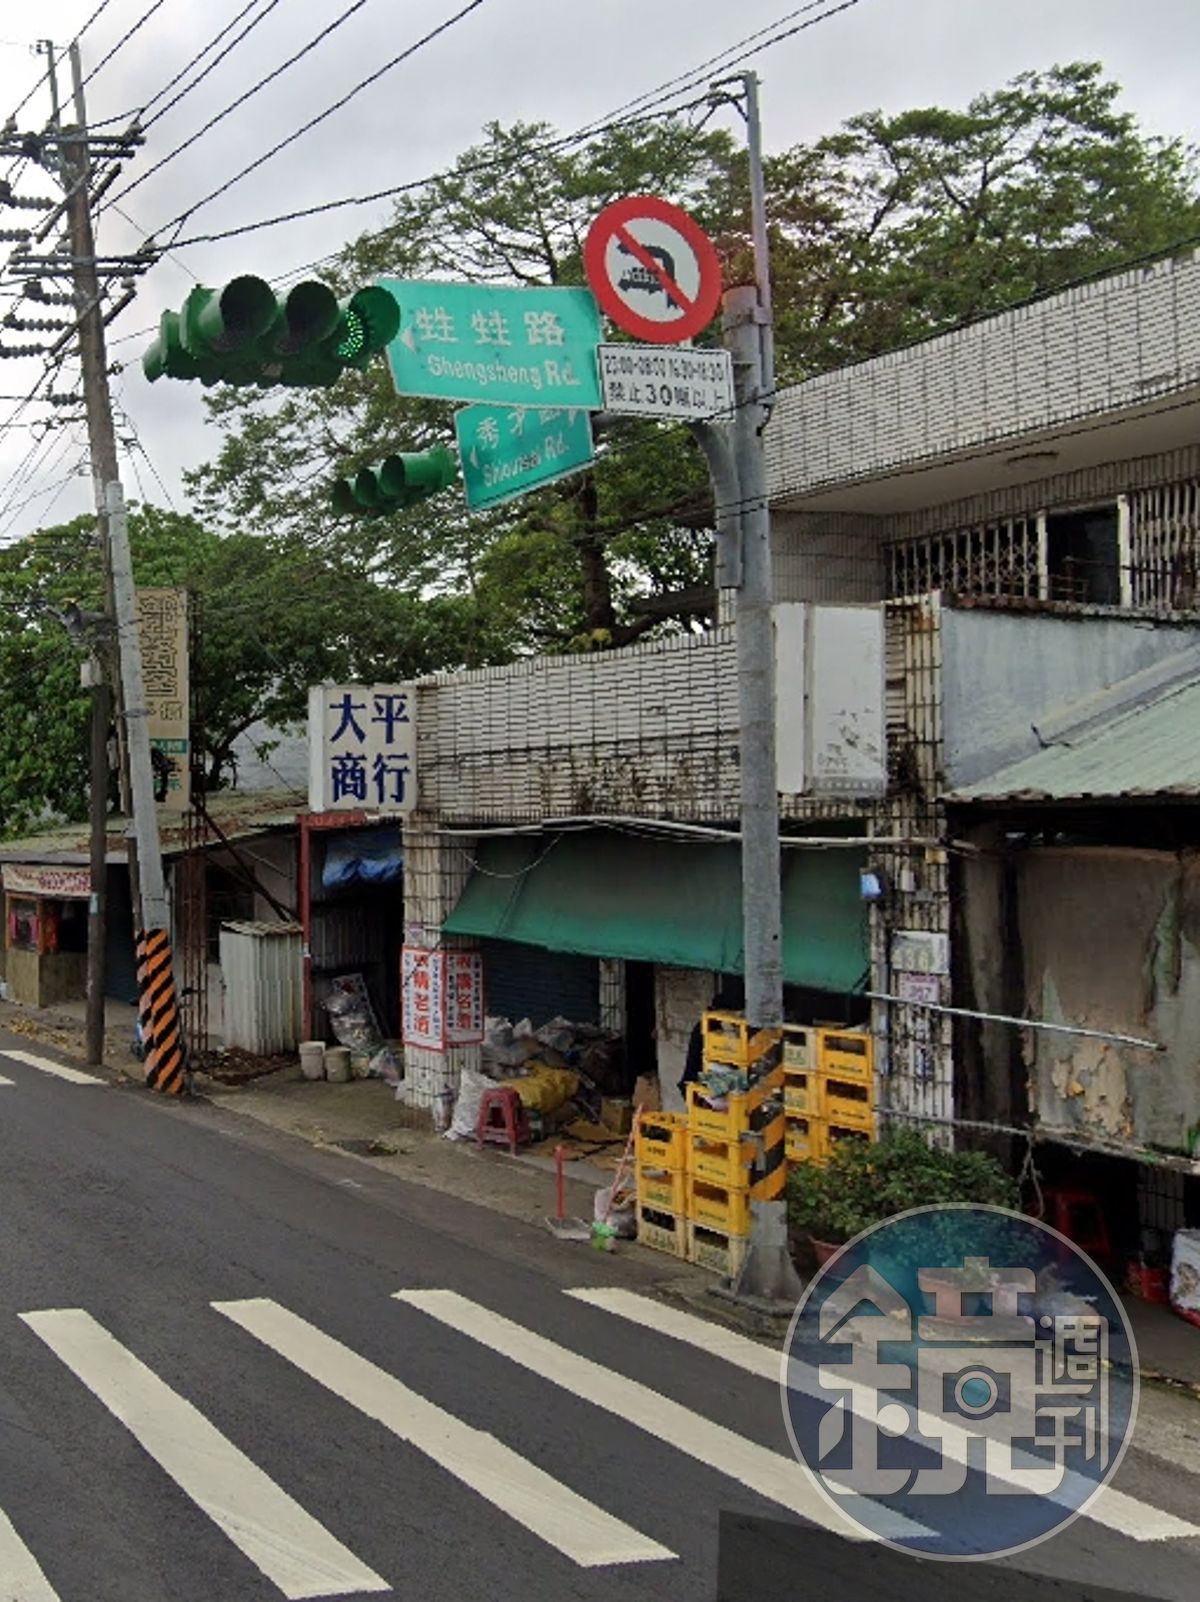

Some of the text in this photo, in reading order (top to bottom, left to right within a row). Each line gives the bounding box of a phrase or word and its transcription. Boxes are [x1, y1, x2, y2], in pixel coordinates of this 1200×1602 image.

[428, 354, 581, 390] Shengsheng Rd.
[329, 693, 410, 744] 大平
[330, 752, 410, 803] 商行
